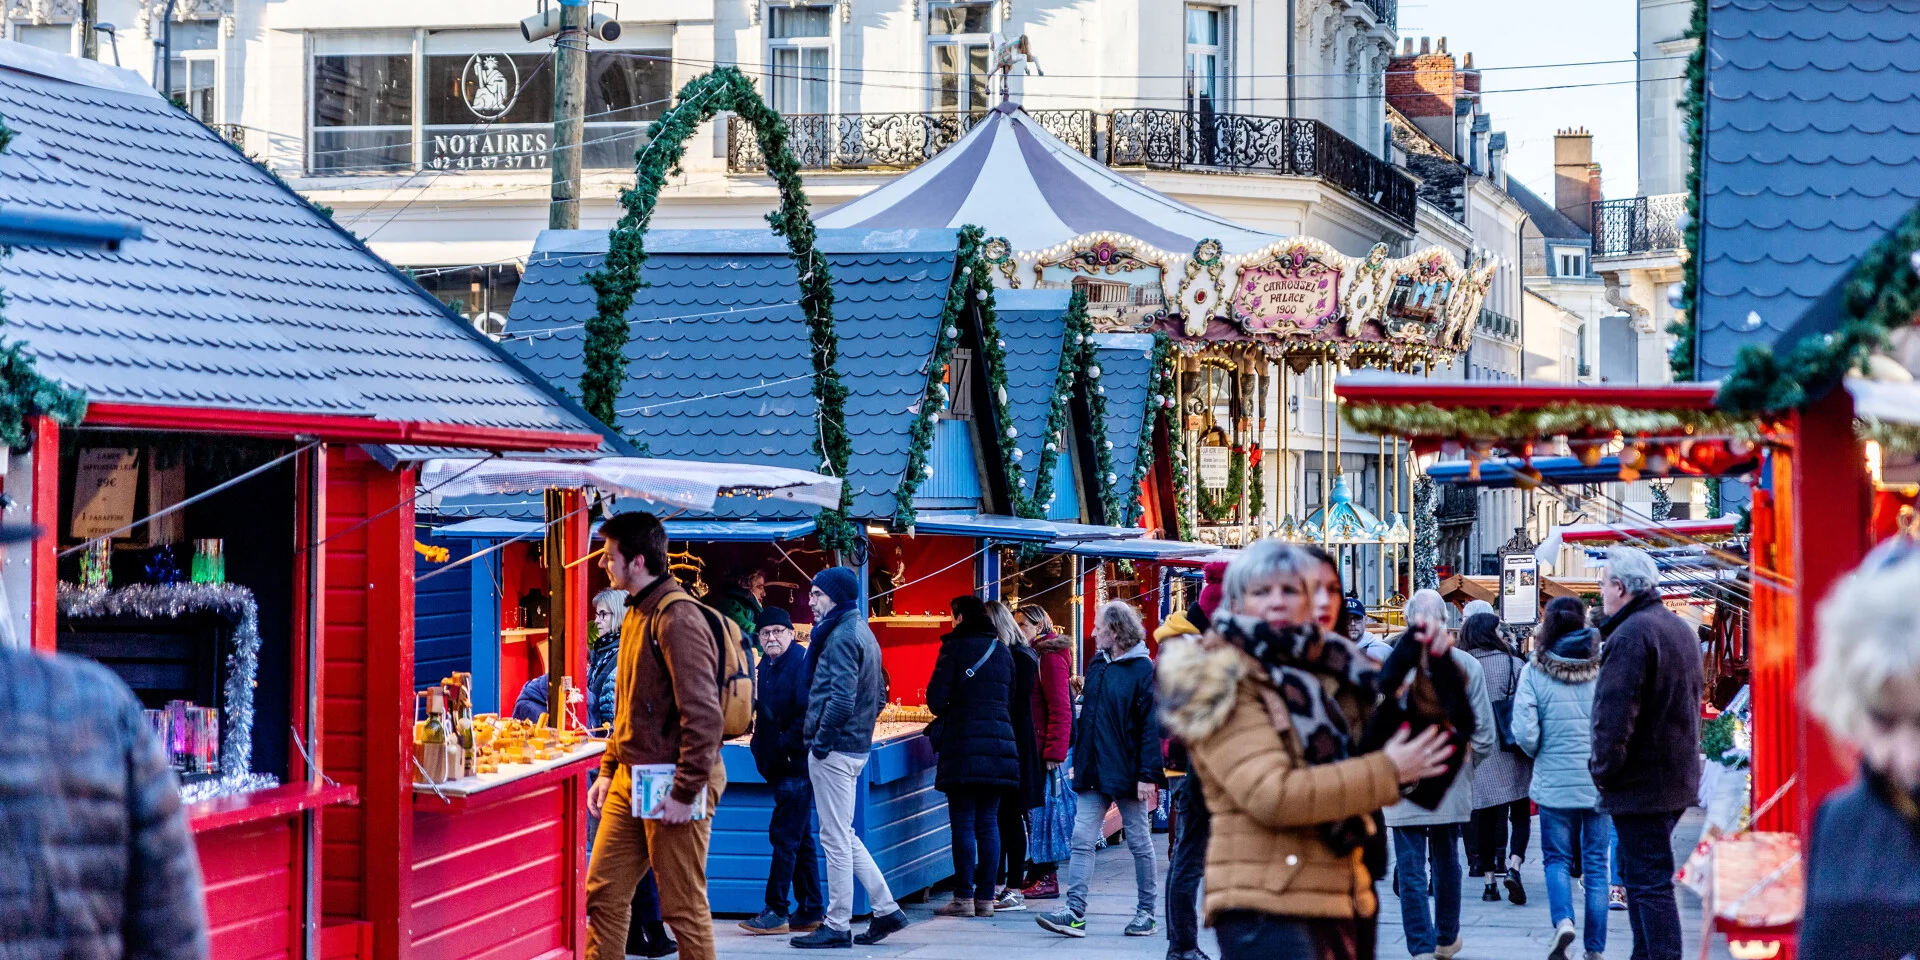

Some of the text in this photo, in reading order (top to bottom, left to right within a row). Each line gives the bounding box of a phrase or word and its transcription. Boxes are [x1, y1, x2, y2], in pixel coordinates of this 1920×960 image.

[434, 133, 547, 154] NOTAIRES
[433, 155, 547, 169] 02 41 87 37 17
[1263, 279, 1316, 293] CARROUSEL
[1270, 293, 1306, 303] PALACE
[1276, 305, 1297, 314] 1900
